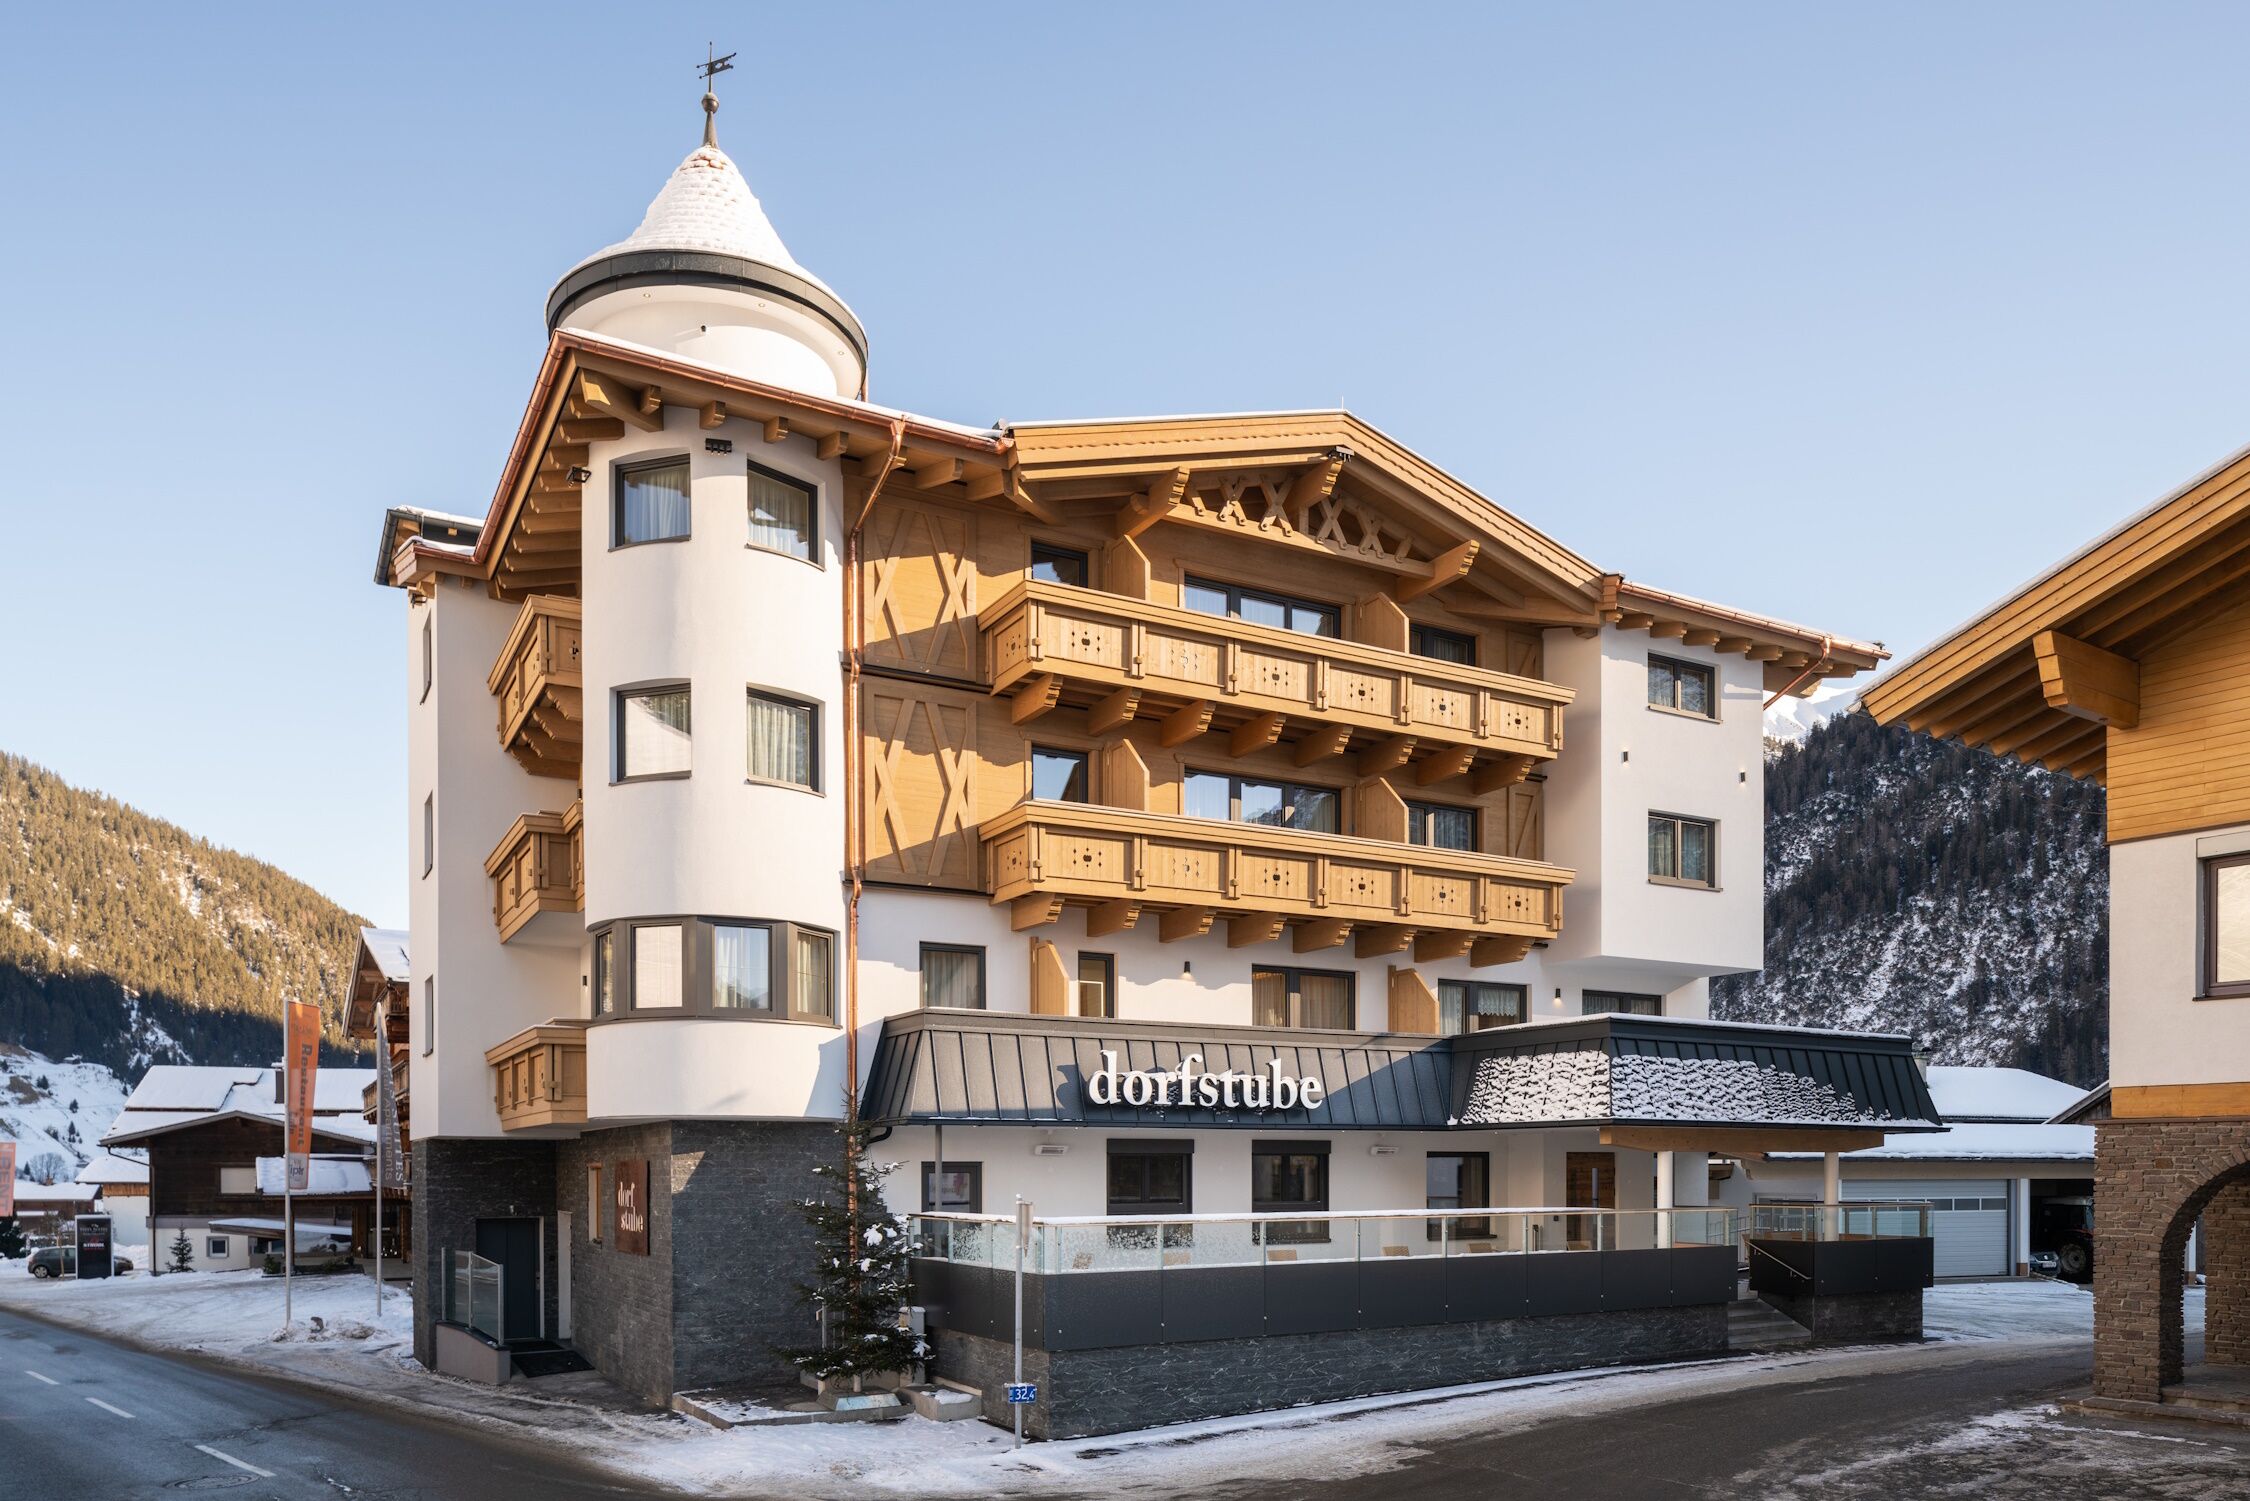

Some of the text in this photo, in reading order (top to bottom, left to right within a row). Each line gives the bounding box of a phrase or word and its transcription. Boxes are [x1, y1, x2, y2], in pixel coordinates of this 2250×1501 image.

[298, 1044, 312, 1145] Restaurant
[1088, 1049, 1323, 1110] dorfstube
[617, 1181, 636, 1208] dorf
[621, 1206, 644, 1233] stube
